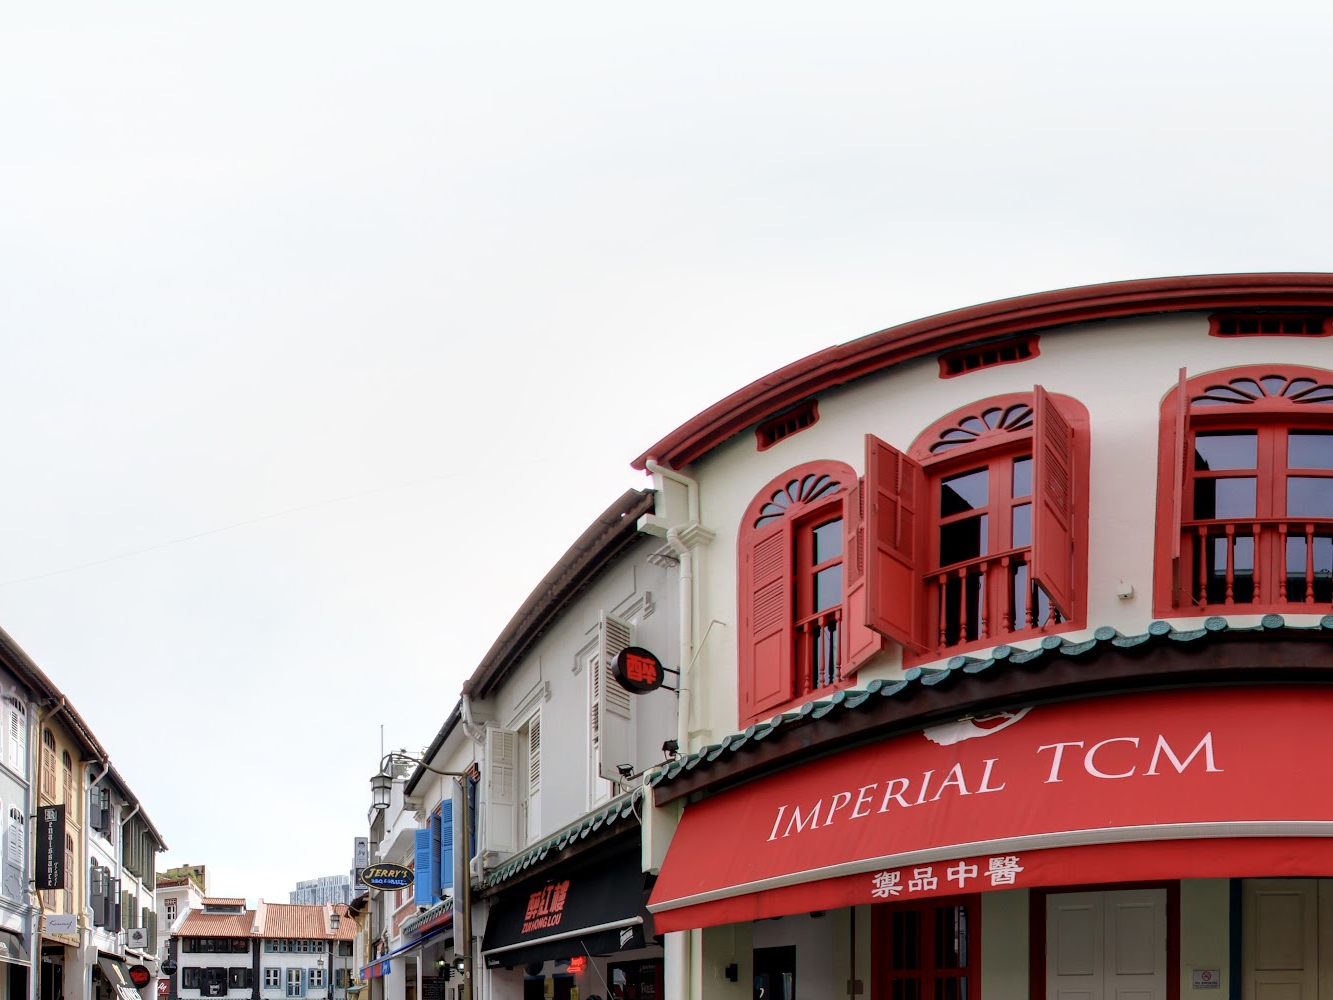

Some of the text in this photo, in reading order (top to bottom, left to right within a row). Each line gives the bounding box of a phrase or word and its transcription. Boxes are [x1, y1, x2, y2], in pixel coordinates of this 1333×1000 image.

[766, 731, 1224, 842] IMPERIAL TCM
[364, 868, 408, 880] JERRY'S
[547, 912, 563, 927] LOU
